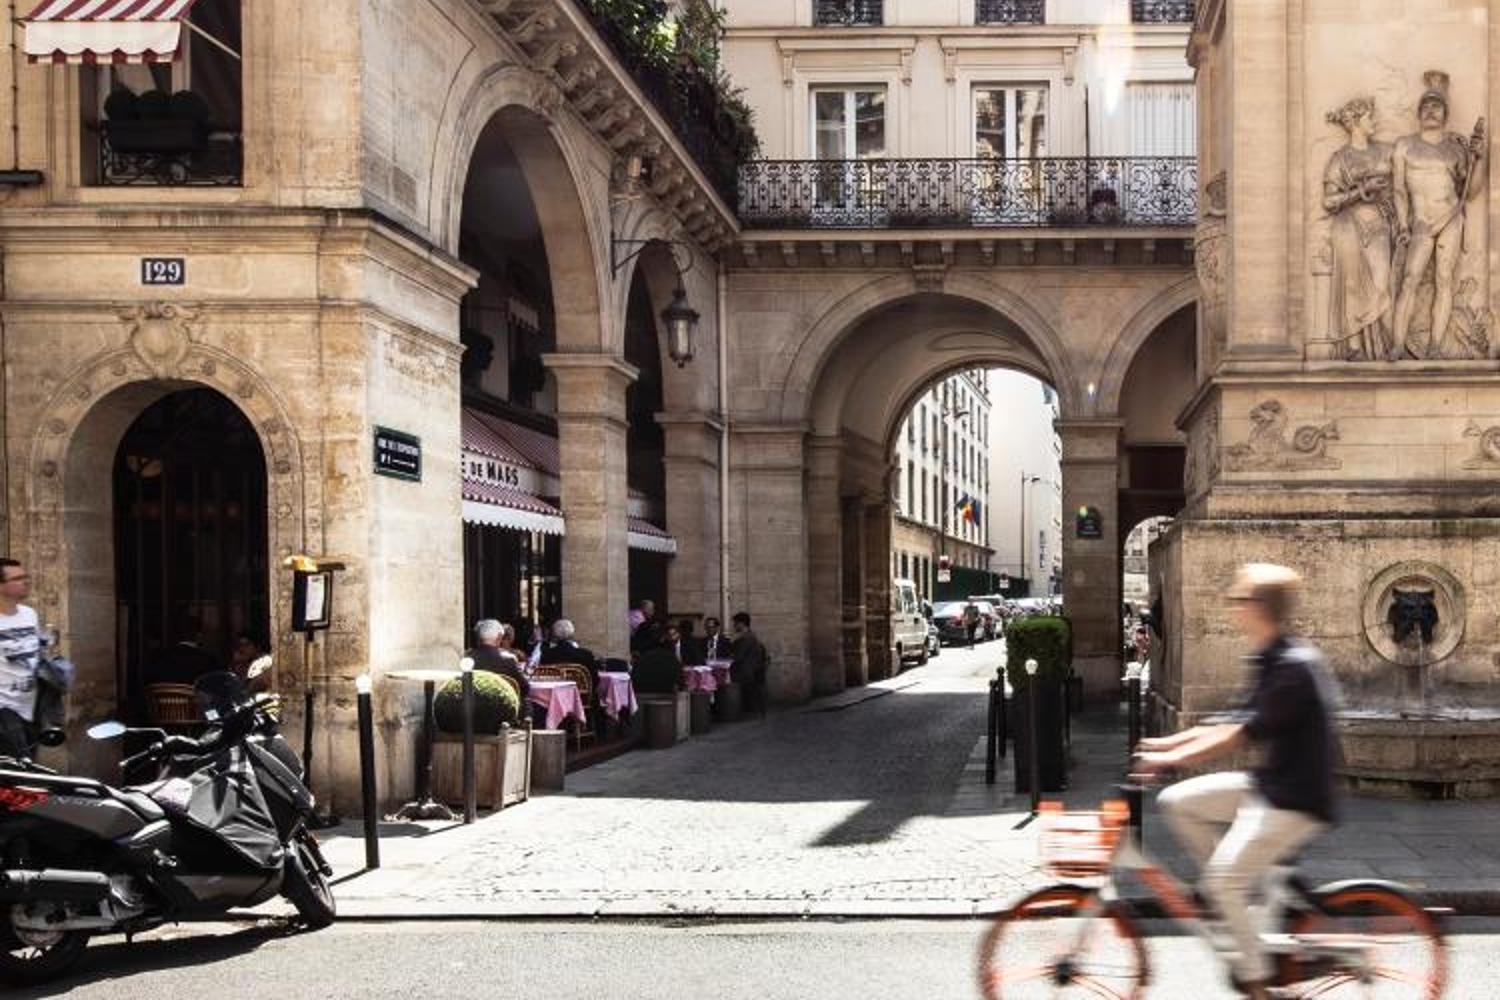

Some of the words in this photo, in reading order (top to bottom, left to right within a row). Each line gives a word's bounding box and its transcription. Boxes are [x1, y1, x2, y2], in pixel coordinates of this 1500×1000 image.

[145, 261, 181, 281] 129
[471, 461, 483, 478] DE
[487, 461, 519, 487] MARS
